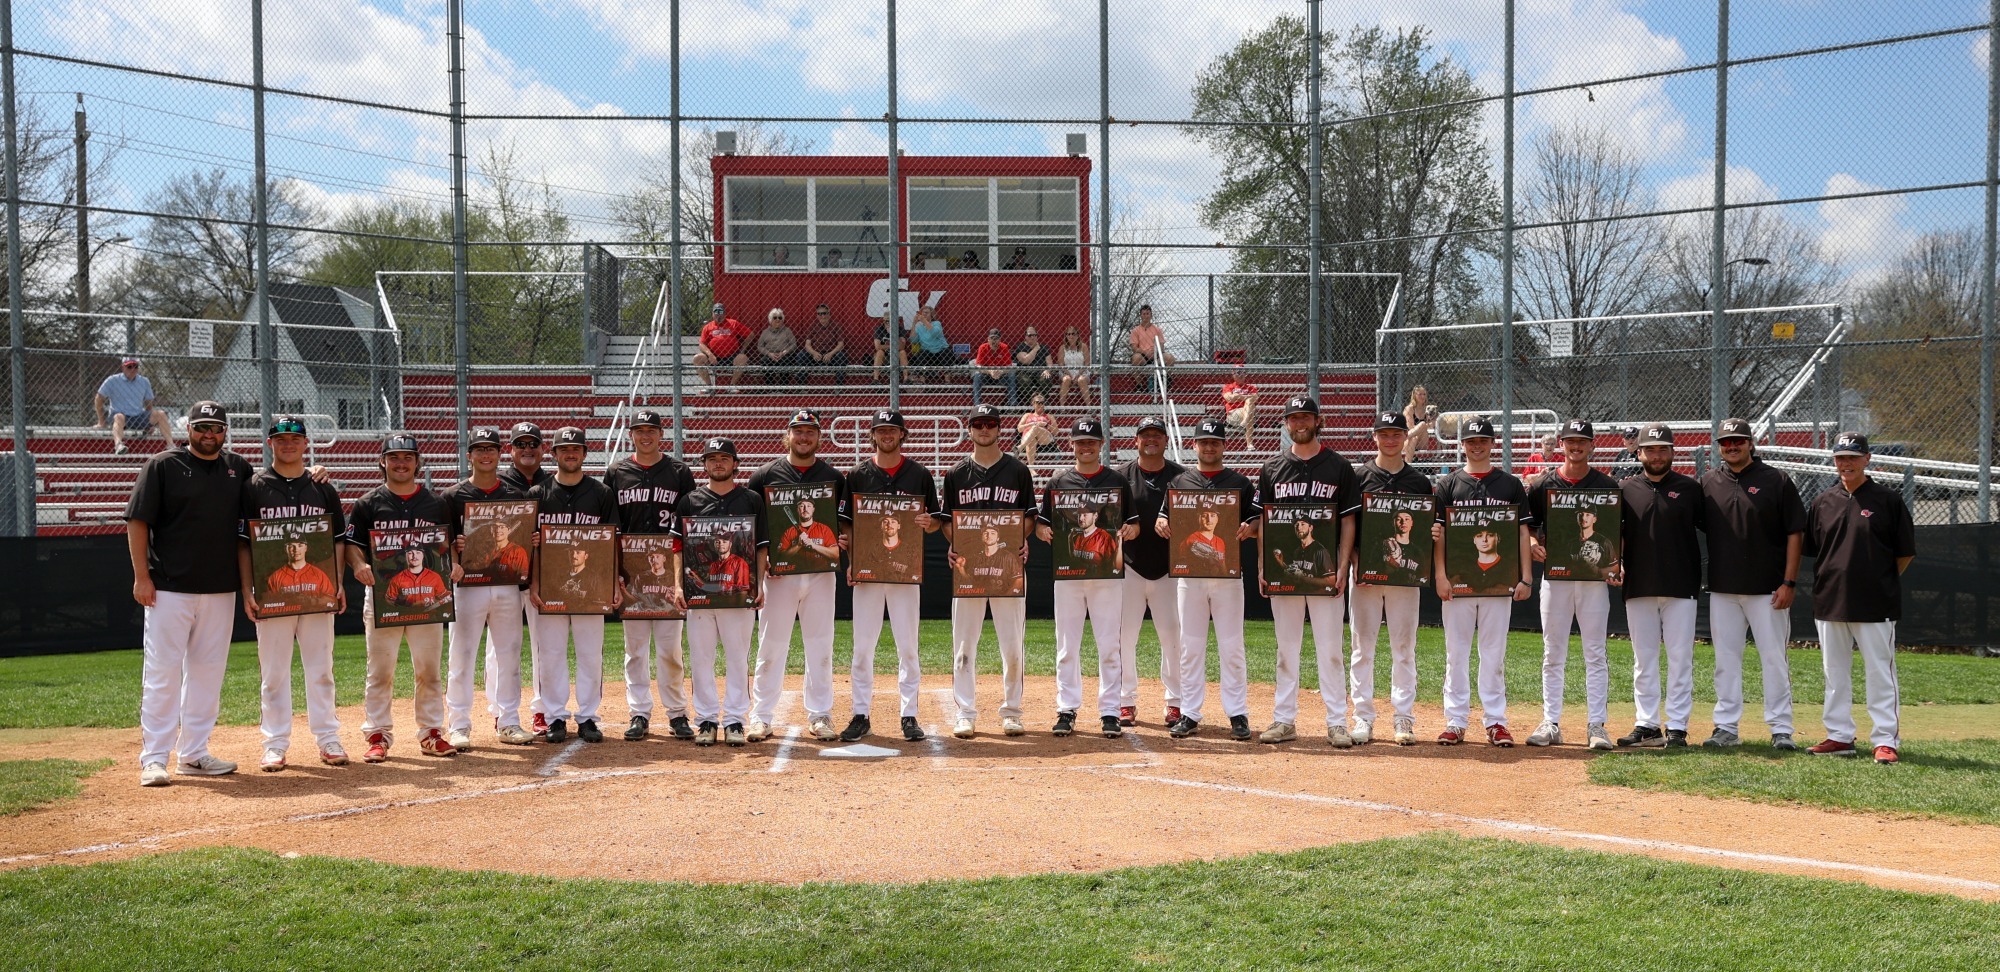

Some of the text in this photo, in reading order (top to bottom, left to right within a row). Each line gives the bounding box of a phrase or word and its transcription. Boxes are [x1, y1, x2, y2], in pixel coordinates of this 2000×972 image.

[1291, 398, 1306, 408] GV
[201, 405, 217, 416] GV
[978, 405, 991, 414] GV
[638, 411, 652, 421] GV
[879, 411, 893, 421] GV
[1381, 413, 1397, 423] GV
[518, 424, 532, 433] GV
[1078, 422, 1093, 432] GV
[1202, 423, 1217, 433] GV
[1469, 423, 1483, 432] GV
[1570, 421, 1585, 431] GV
[1723, 423, 1738, 431] GV
[477, 429, 492, 438] GV
[562, 430, 576, 441] GV
[1648, 428, 1663, 439] GV
[709, 438, 723, 449] GV
[768, 487, 833, 501] VIKINGS
[1274, 480, 1337, 499] GRAND VIEW
[618, 487, 678, 505] GRAND VIEW
[958, 486, 1020, 505] GRAND VIEW
[1054, 493, 1119, 504] VIKINGS
[1172, 494, 1237, 505] VIKINGS
[1550, 493, 1618, 505] VIKINGS
[468, 504, 534, 516] VIKINGS
[856, 499, 920, 511] VIKINGS
[1366, 498, 1433, 511] VIKINGS
[260, 504, 326, 519] GRAND VIEW
[1449, 510, 1516, 522] VIKINGS
[415, 518, 436, 528] VIE
[538, 512, 600, 529] GRAND VIEW
[956, 515, 1021, 526] VIKINGS
[254, 521, 329, 537] VIKINGS
[686, 521, 751, 533] VIKINGS
[374, 531, 446, 546] VIKINGS
[545, 529, 612, 541] VIKINGS
[620, 538, 673, 549] VIKING
